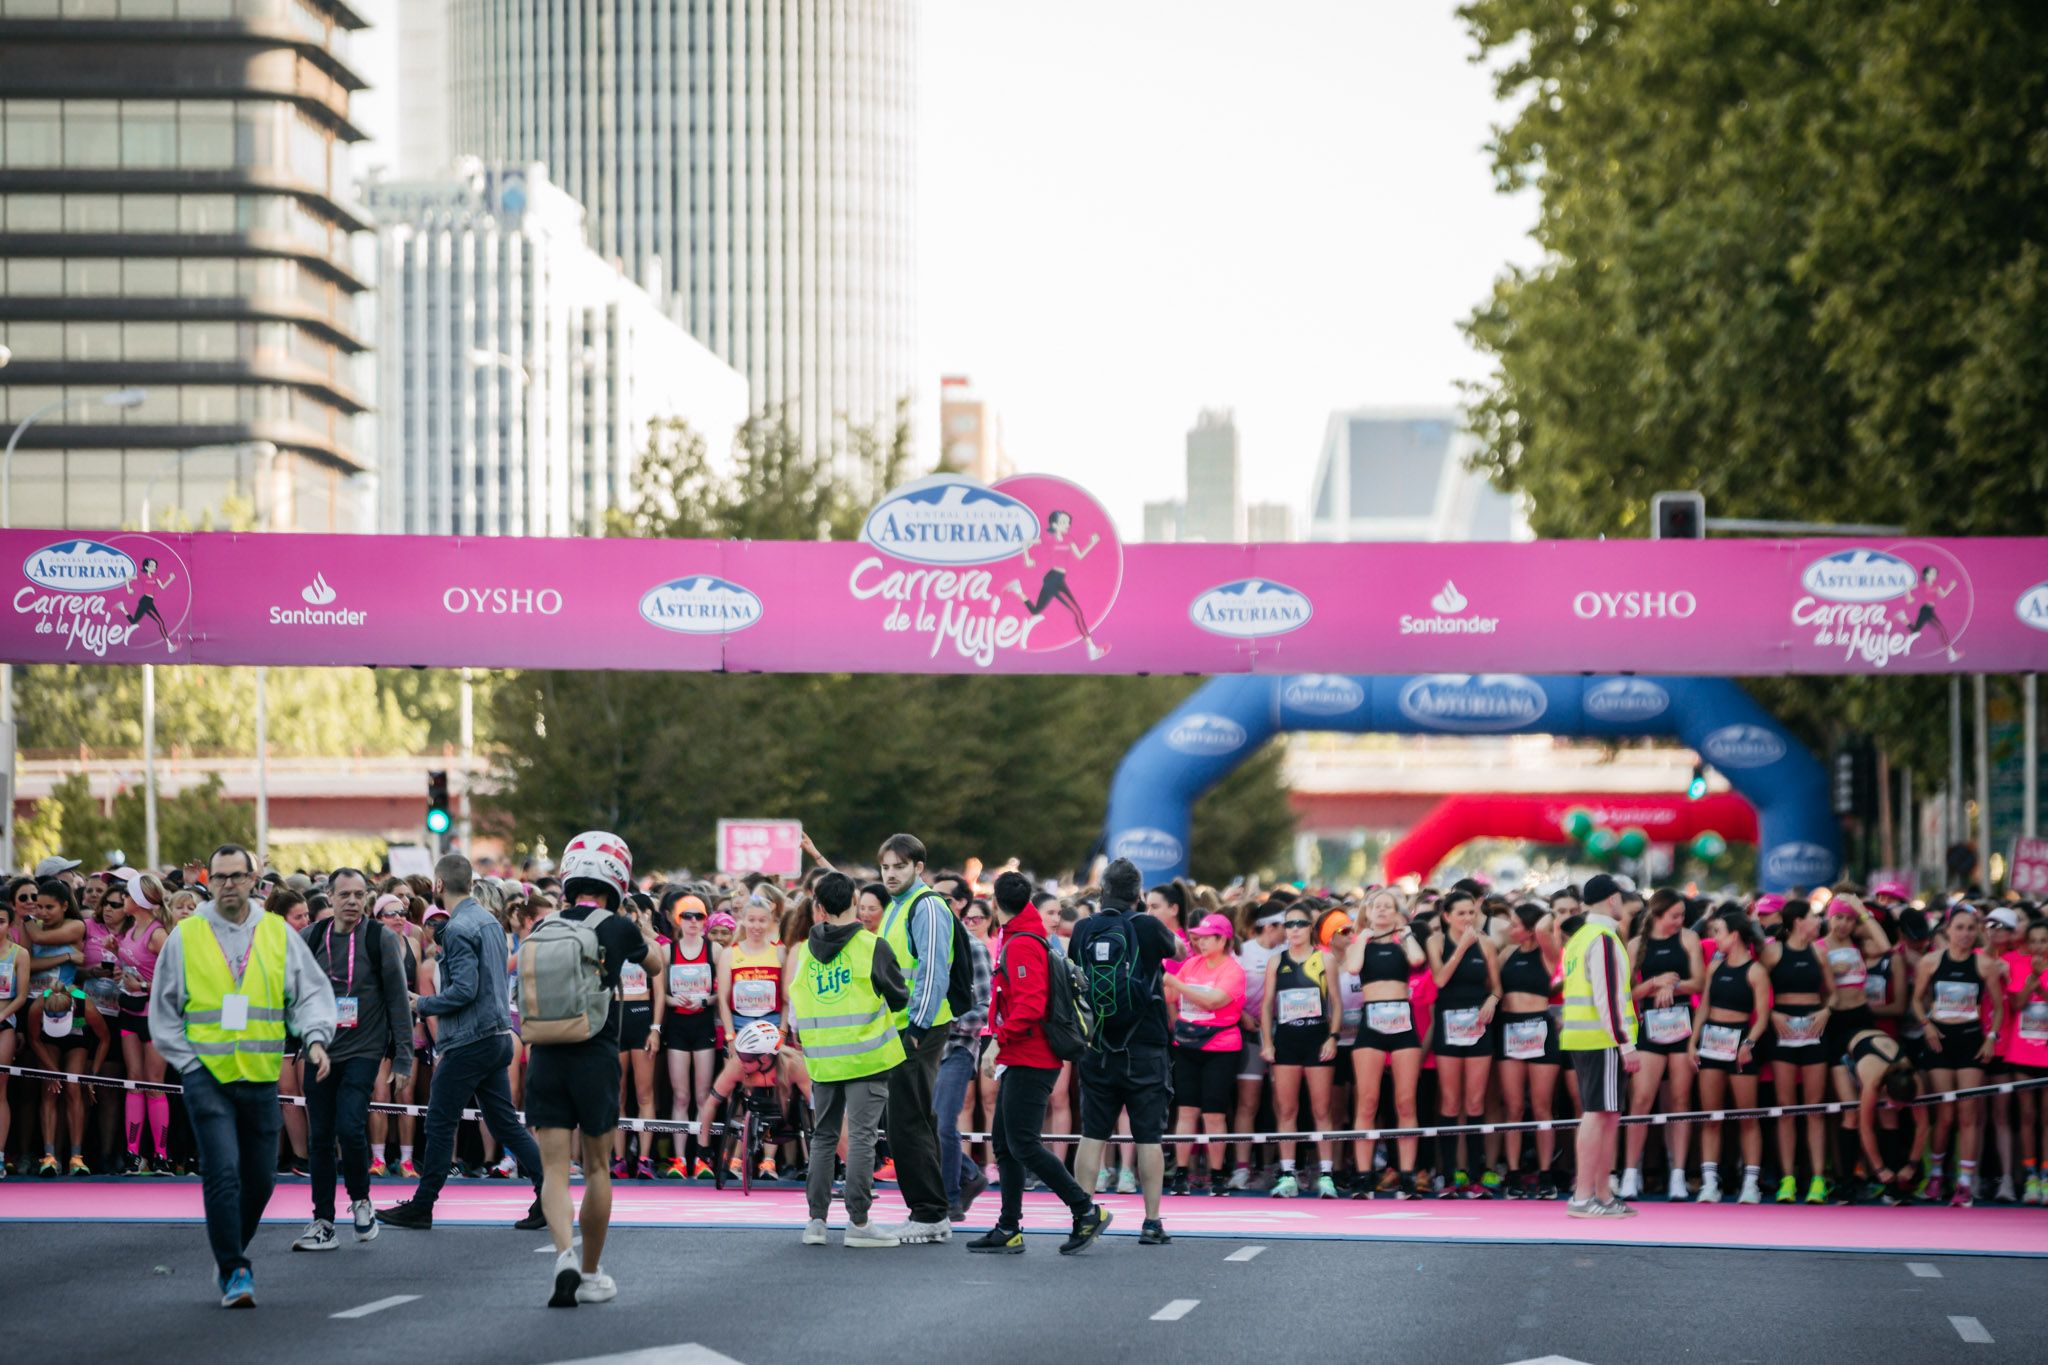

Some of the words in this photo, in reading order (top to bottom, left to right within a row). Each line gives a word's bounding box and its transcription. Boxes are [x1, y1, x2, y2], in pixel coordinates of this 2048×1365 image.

[881, 512, 1024, 542] ASTURIANA
[33, 558, 127, 578] ASTURIANA
[850, 557, 993, 601] Carrera
[1814, 570, 1907, 588] ASTURIANA
[13, 586, 106, 615] Carrera
[443, 587, 563, 615] OYSHO
[650, 597, 752, 618] ASTURIANA
[1201, 601, 1302, 621] ASTURIANA
[1572, 590, 1697, 619] OYSHO
[1792, 597, 1888, 627] Carrera
[269, 606, 368, 626] Santander
[1400, 615, 1499, 635] Santander
[35, 615, 53, 634] de
[56, 615, 69, 634] la
[65, 612, 140, 657] Mujer
[883, 602, 911, 631] de
[916, 602, 936, 632] la
[930, 597, 1045, 668] Mujer
[1814, 624, 1834, 646] de
[1835, 625, 1850, 647] la
[1845, 621, 1921, 669] Mujer
[1416, 685, 1537, 716] ASTURIANA
[816, 966, 852, 995] Life
